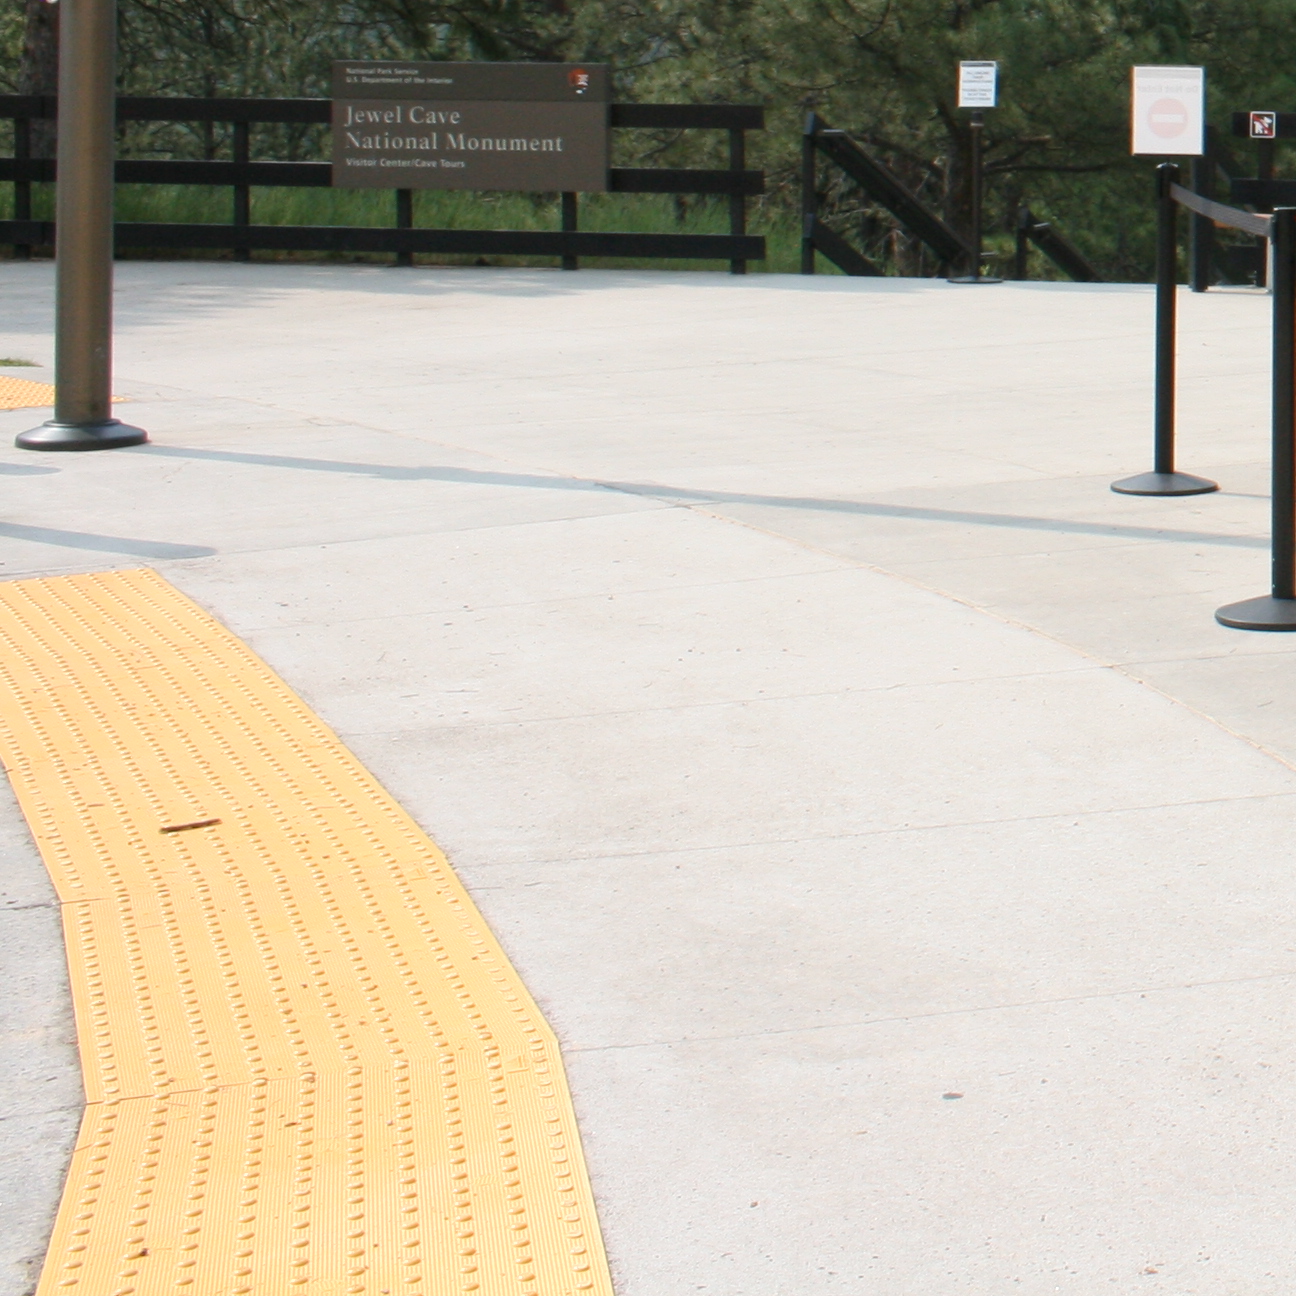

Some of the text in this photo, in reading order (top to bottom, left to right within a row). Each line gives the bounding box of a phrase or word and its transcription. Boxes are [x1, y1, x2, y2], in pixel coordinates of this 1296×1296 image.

[344, 105, 460, 127] Jewel Cave
[345, 131, 563, 152] National Monument
[346, 158, 465, 168] Visitor Center/Cave Tours
